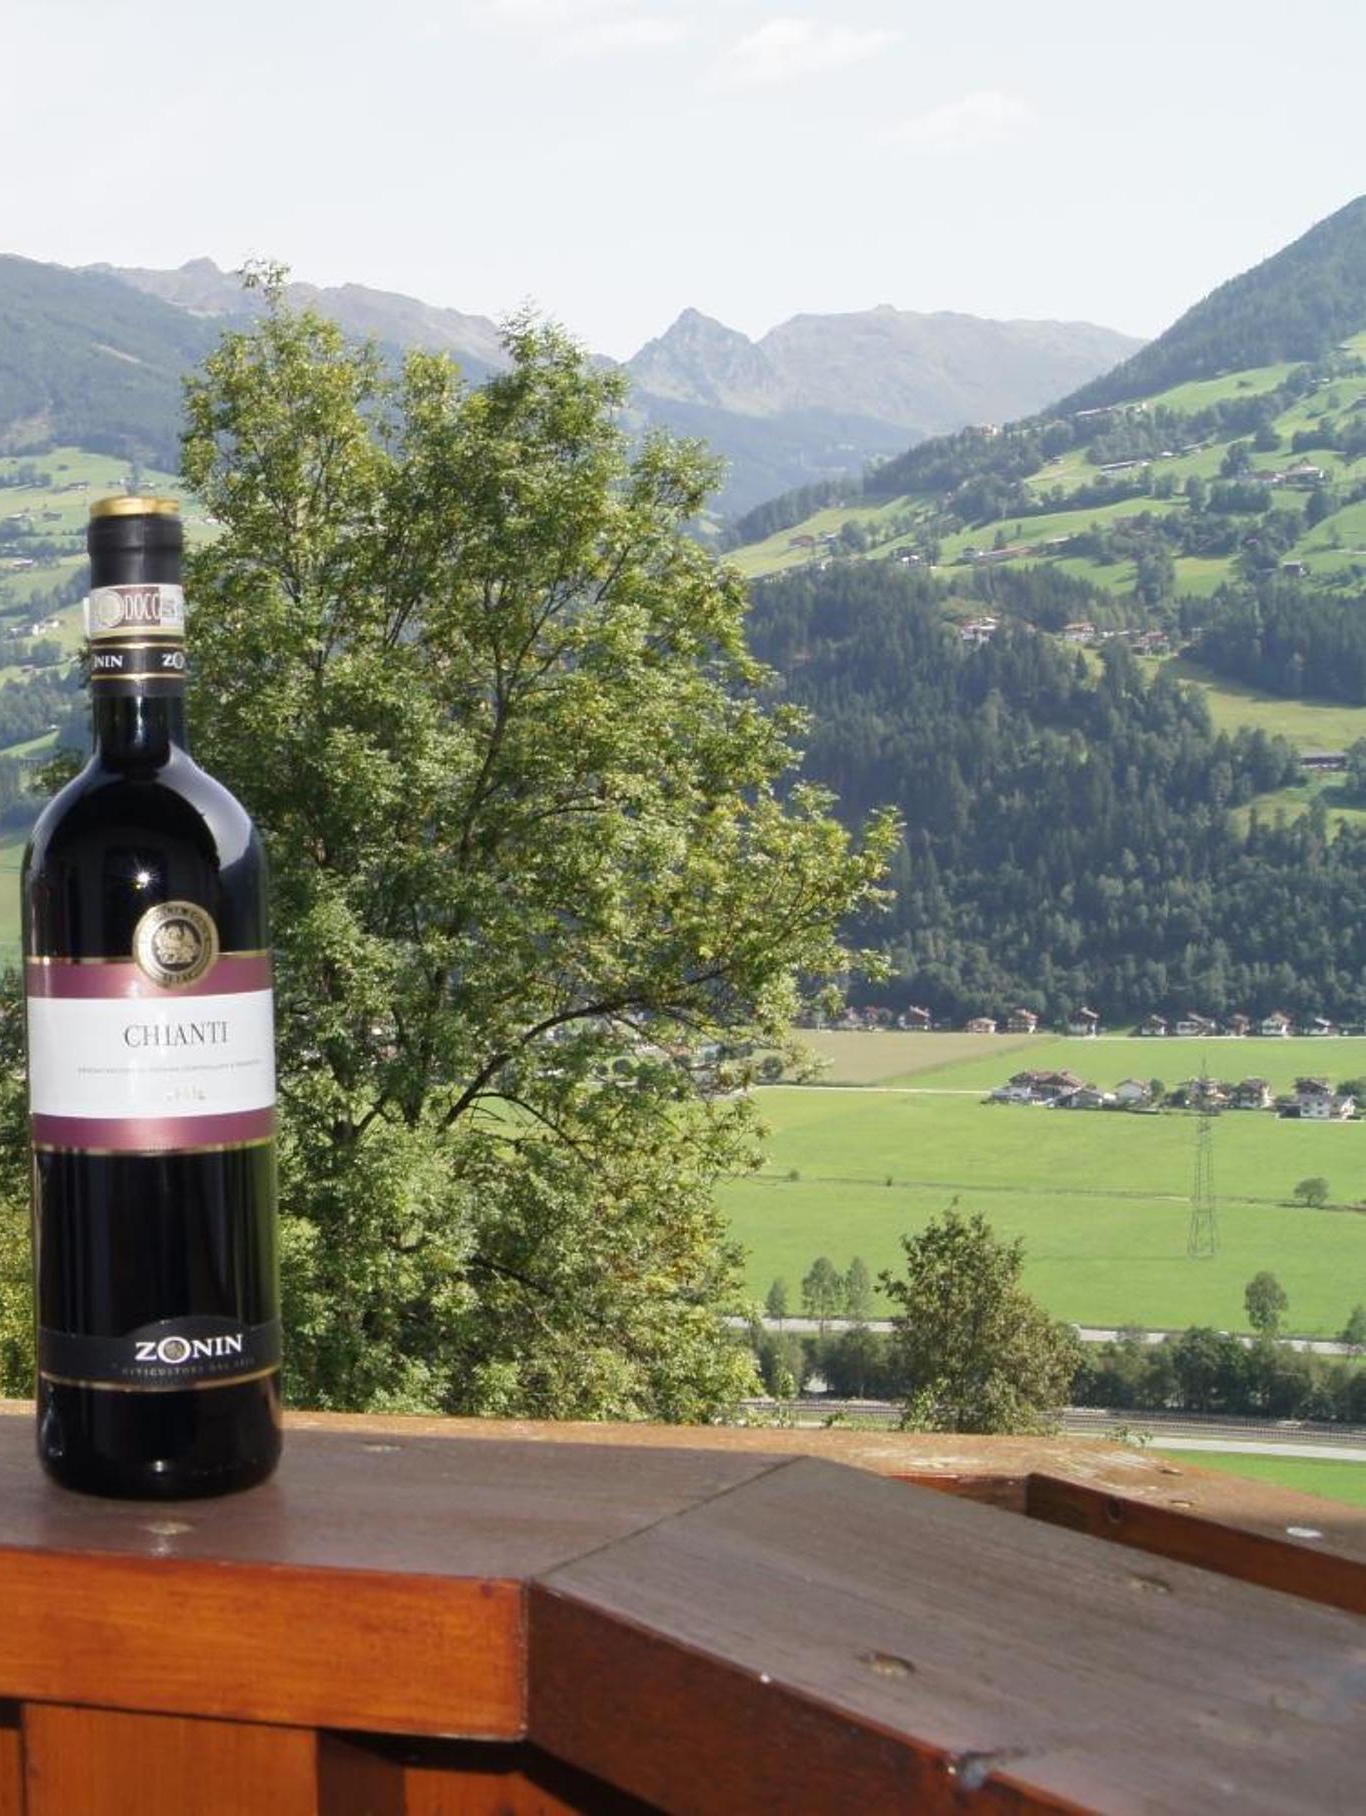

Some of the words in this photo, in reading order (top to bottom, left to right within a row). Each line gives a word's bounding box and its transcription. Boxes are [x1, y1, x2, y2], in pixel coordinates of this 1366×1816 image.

[91, 654, 123, 669] NIN
[123, 1020, 229, 1048] CHIANTI
[134, 1333, 243, 1364] ZONIN
